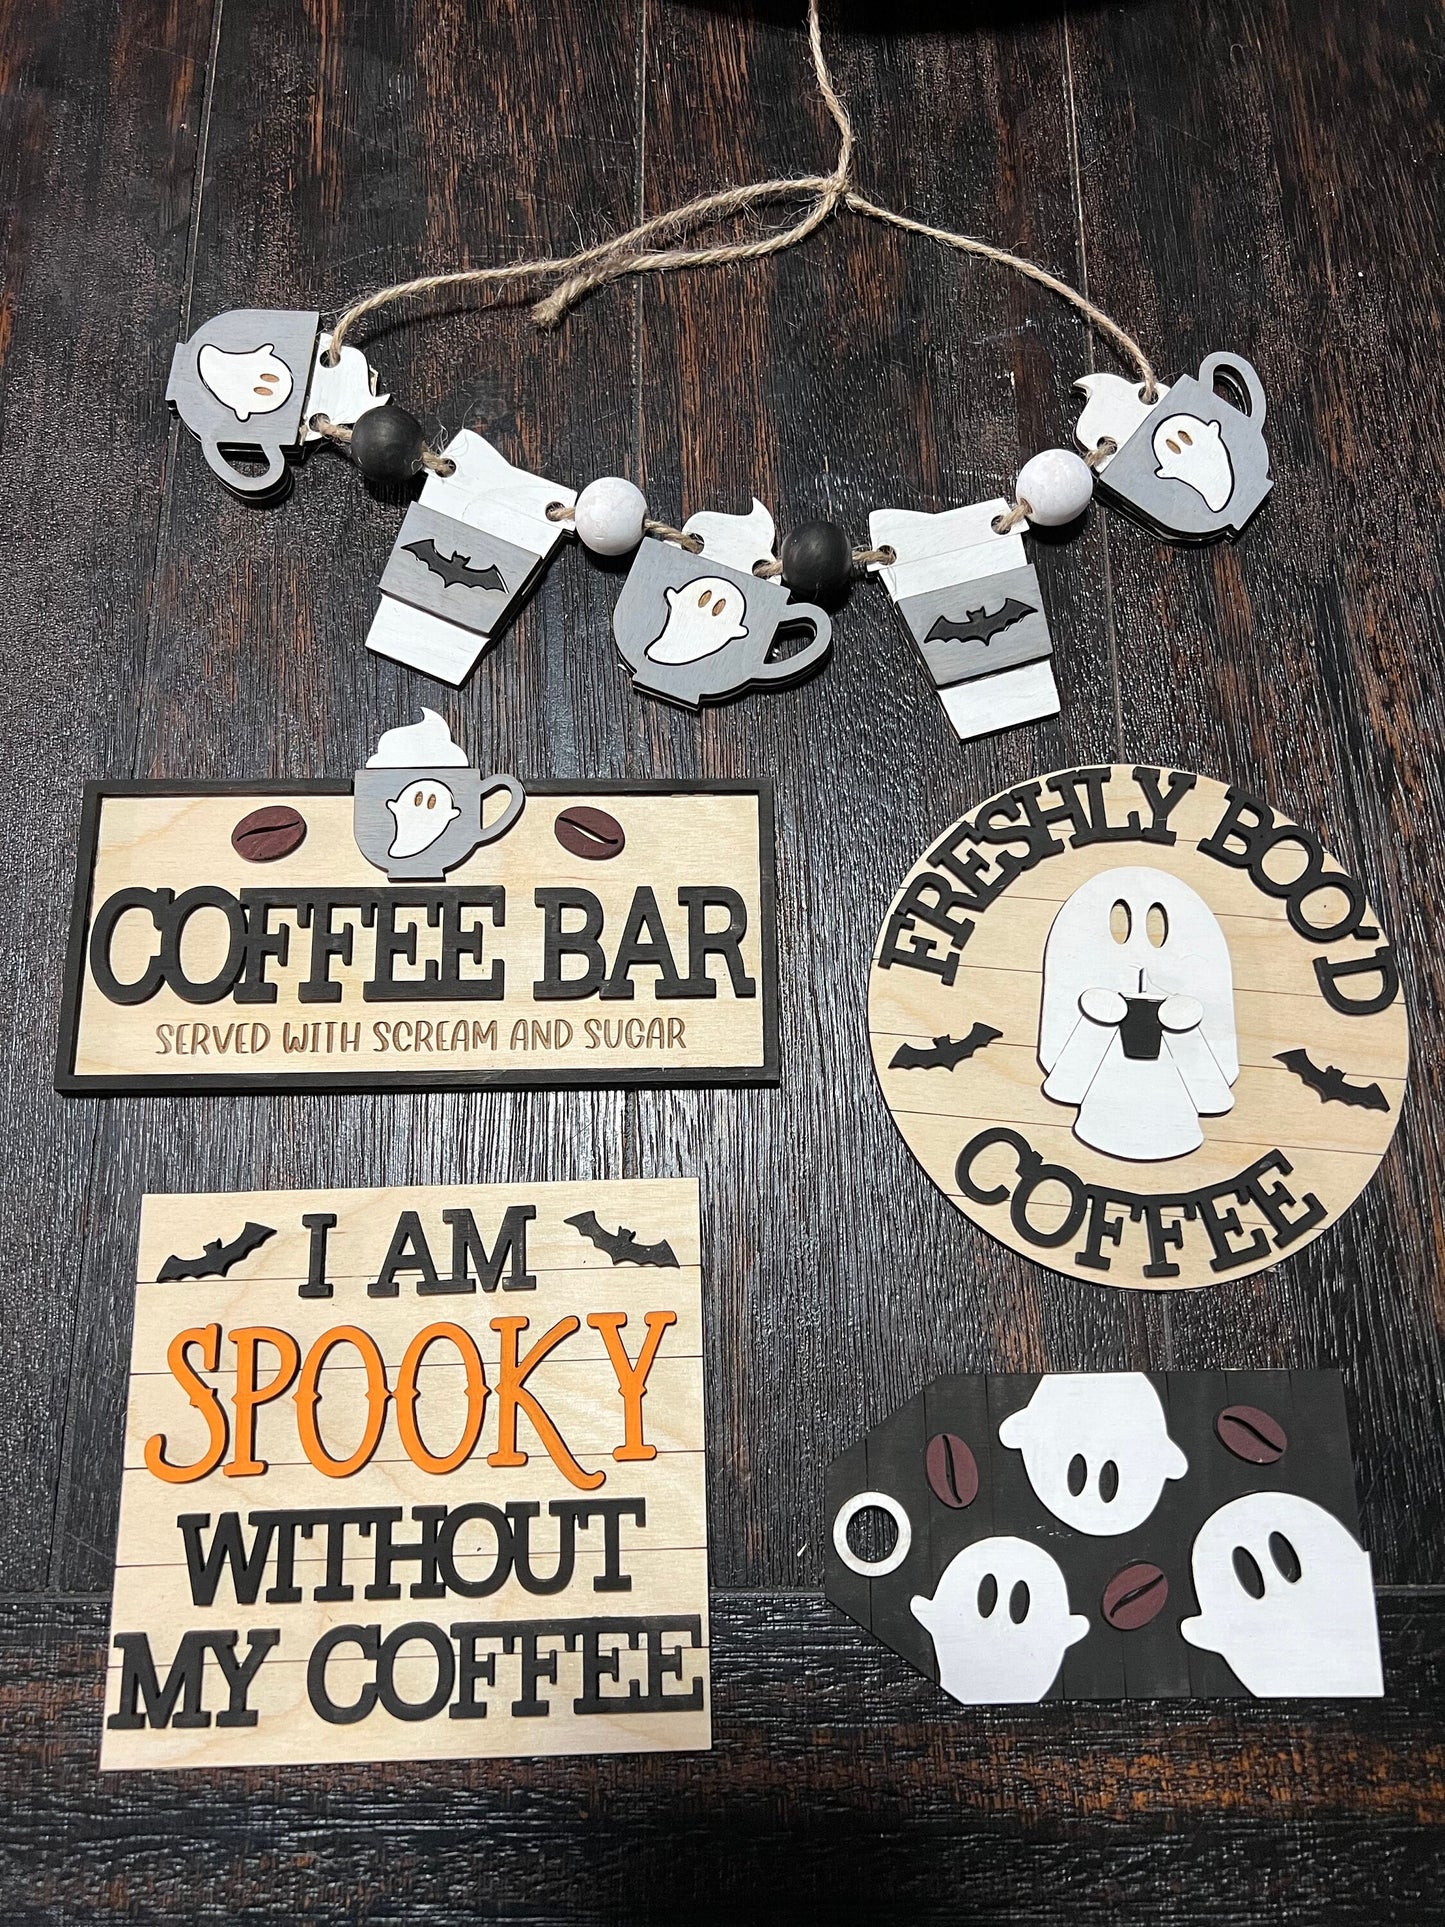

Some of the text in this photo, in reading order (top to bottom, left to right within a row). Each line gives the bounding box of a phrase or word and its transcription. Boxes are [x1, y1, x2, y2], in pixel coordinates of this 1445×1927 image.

[877, 766, 1197, 986] FRESHLY
[90, 885, 756, 1005] COFFEE BAR
[155, 1017, 687, 1056] SERVED WITH SCREAM AND SUGAR
[298, 1205, 537, 1298] I AM
[955, 1127, 1328, 1278] COFFEE
[144, 1311, 677, 1490] SPOOKY
[177, 1497, 646, 1606] WITHOUT
[107, 1614, 704, 1731] MY COFFEE
